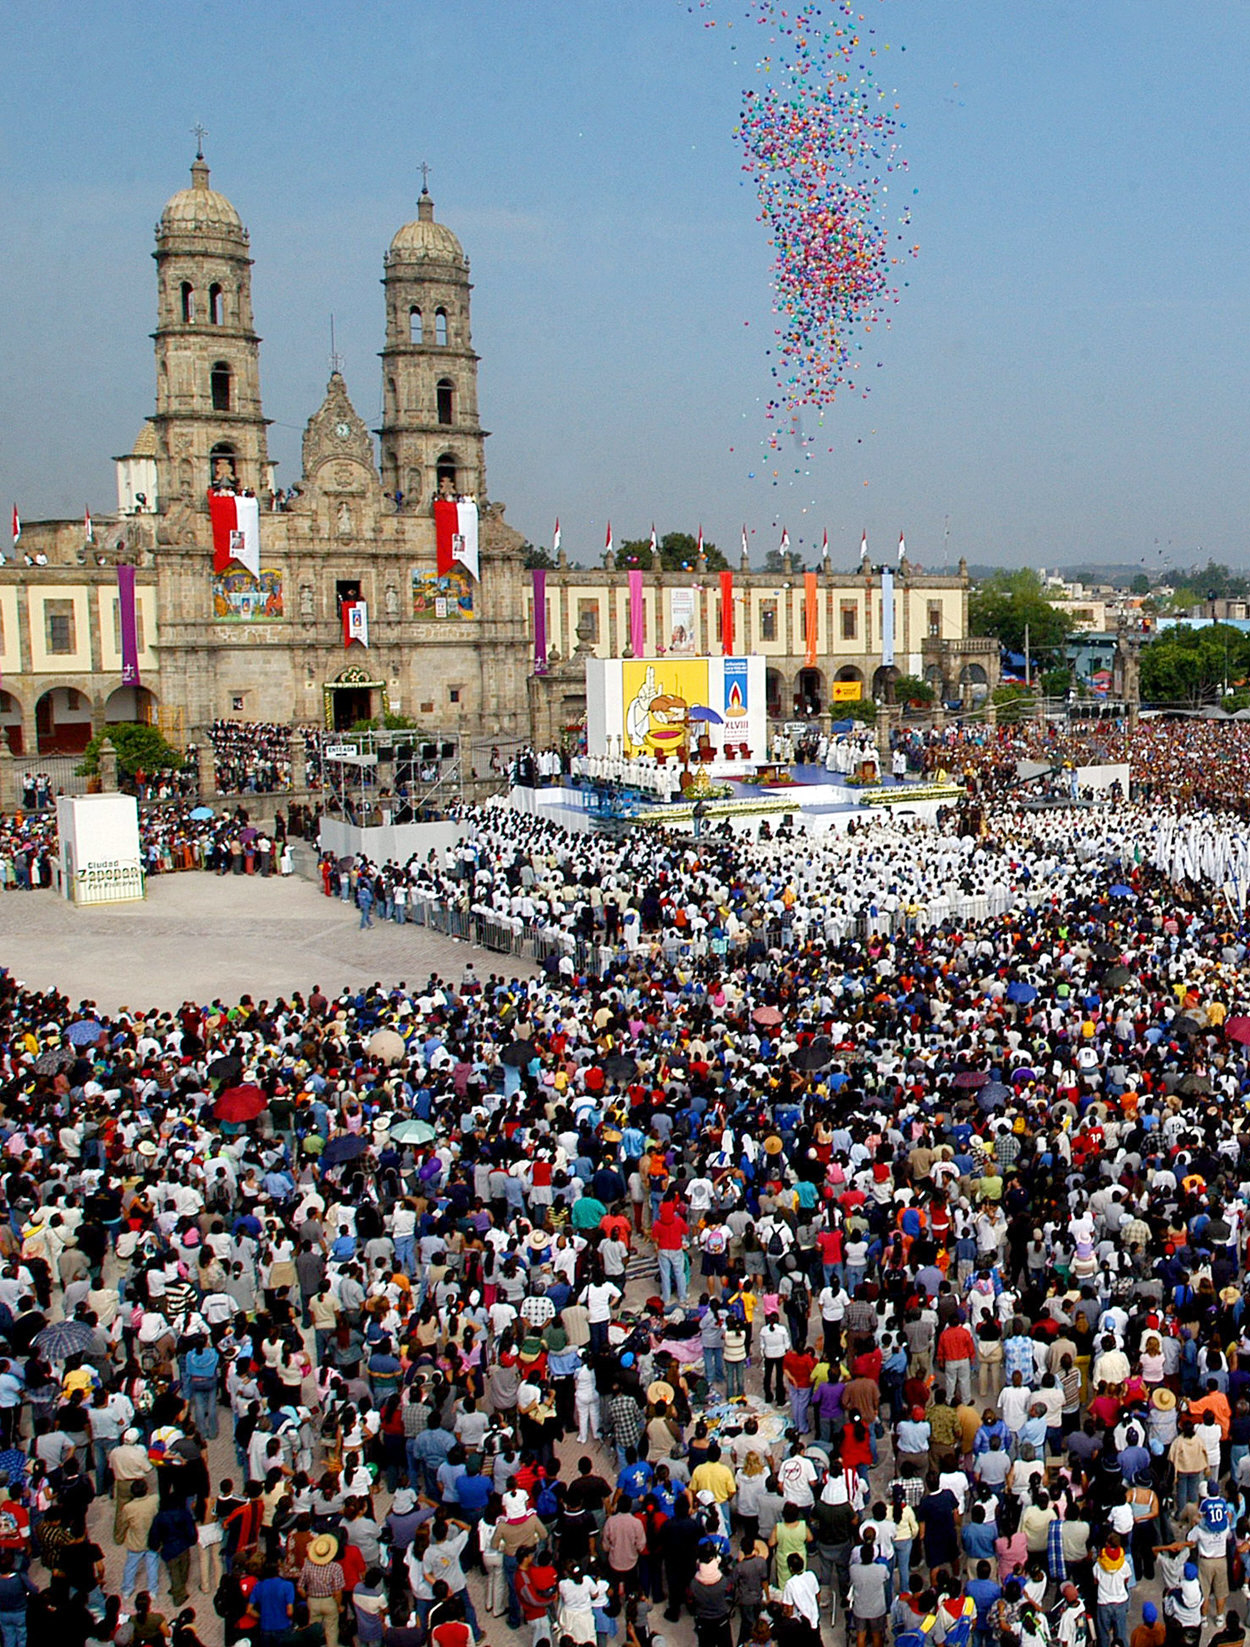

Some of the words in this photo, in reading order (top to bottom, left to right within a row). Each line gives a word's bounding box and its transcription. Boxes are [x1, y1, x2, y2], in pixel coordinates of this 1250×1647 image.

[725, 721, 749, 729] XLVIII
[88, 860, 119, 869] Ciudad
[78, 867, 139, 883] Zapopan
[1210, 1509, 1223, 1523] 10
